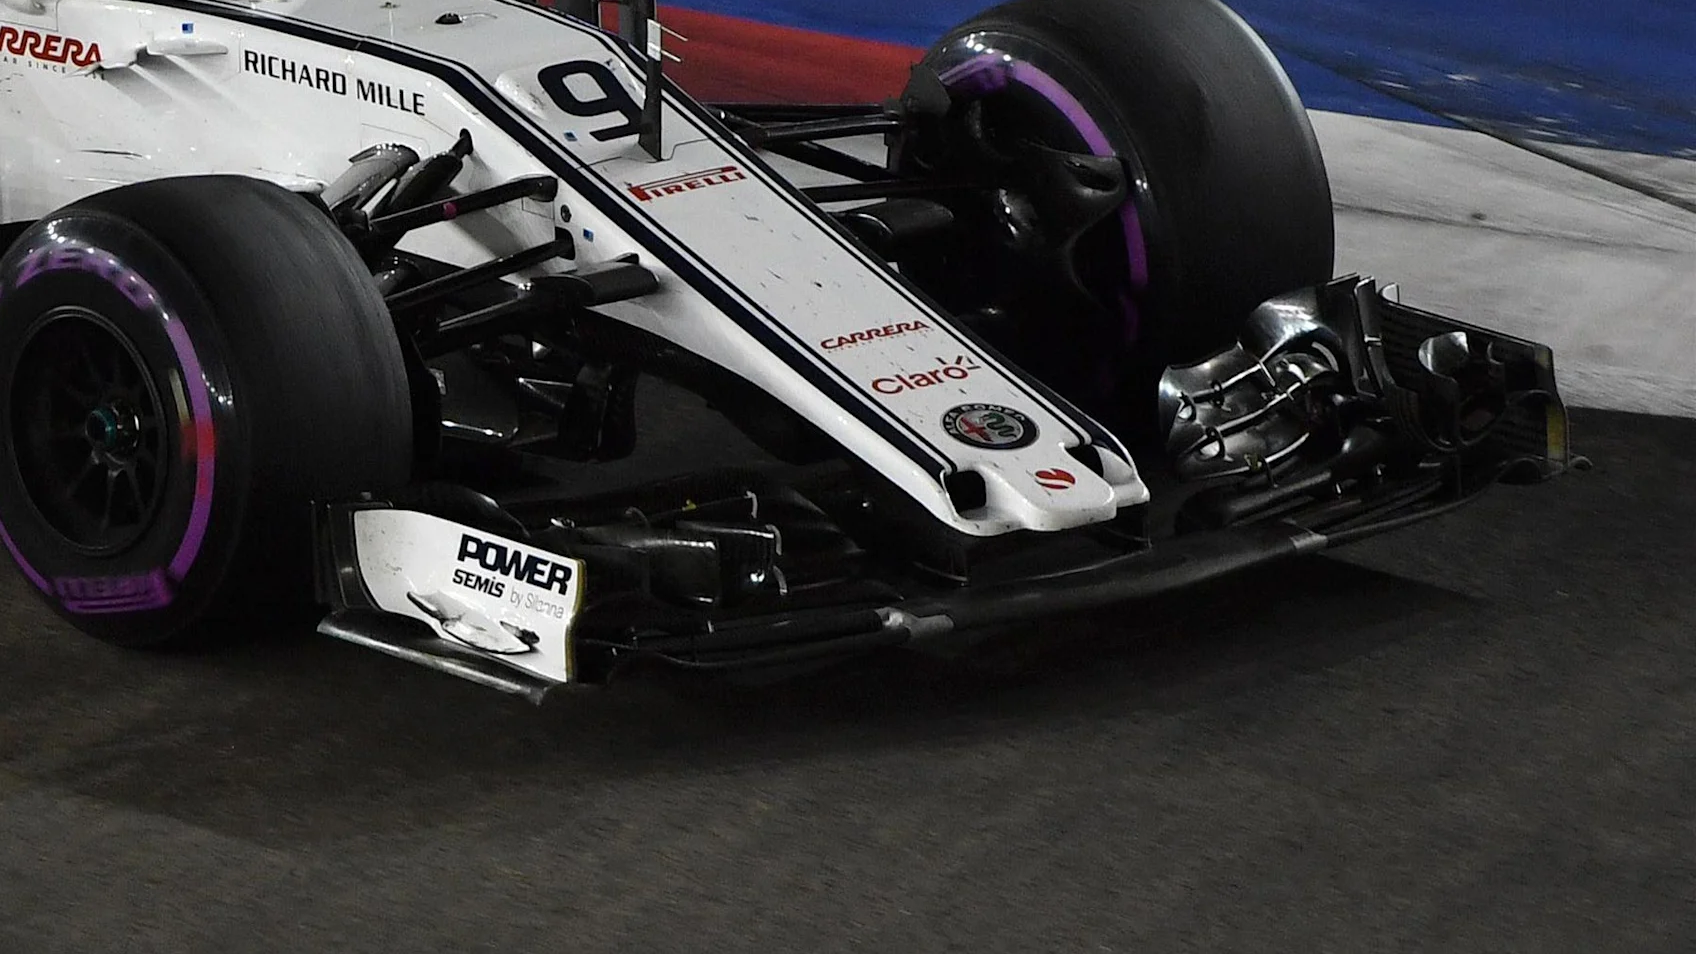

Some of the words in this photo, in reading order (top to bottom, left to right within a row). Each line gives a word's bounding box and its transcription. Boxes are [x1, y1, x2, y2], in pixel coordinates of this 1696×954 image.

[27, 60, 66, 74] SINCE
[244, 50, 347, 96] RICHARD
[356, 79, 426, 116] MILLE
[537, 60, 646, 142] 9
[627, 166, 747, 202] PIRELLI
[820, 320, 931, 350] CARRERA
[871, 364, 968, 395] Claro
[457, 533, 572, 596] POWER
[509, 585, 523, 606] by
